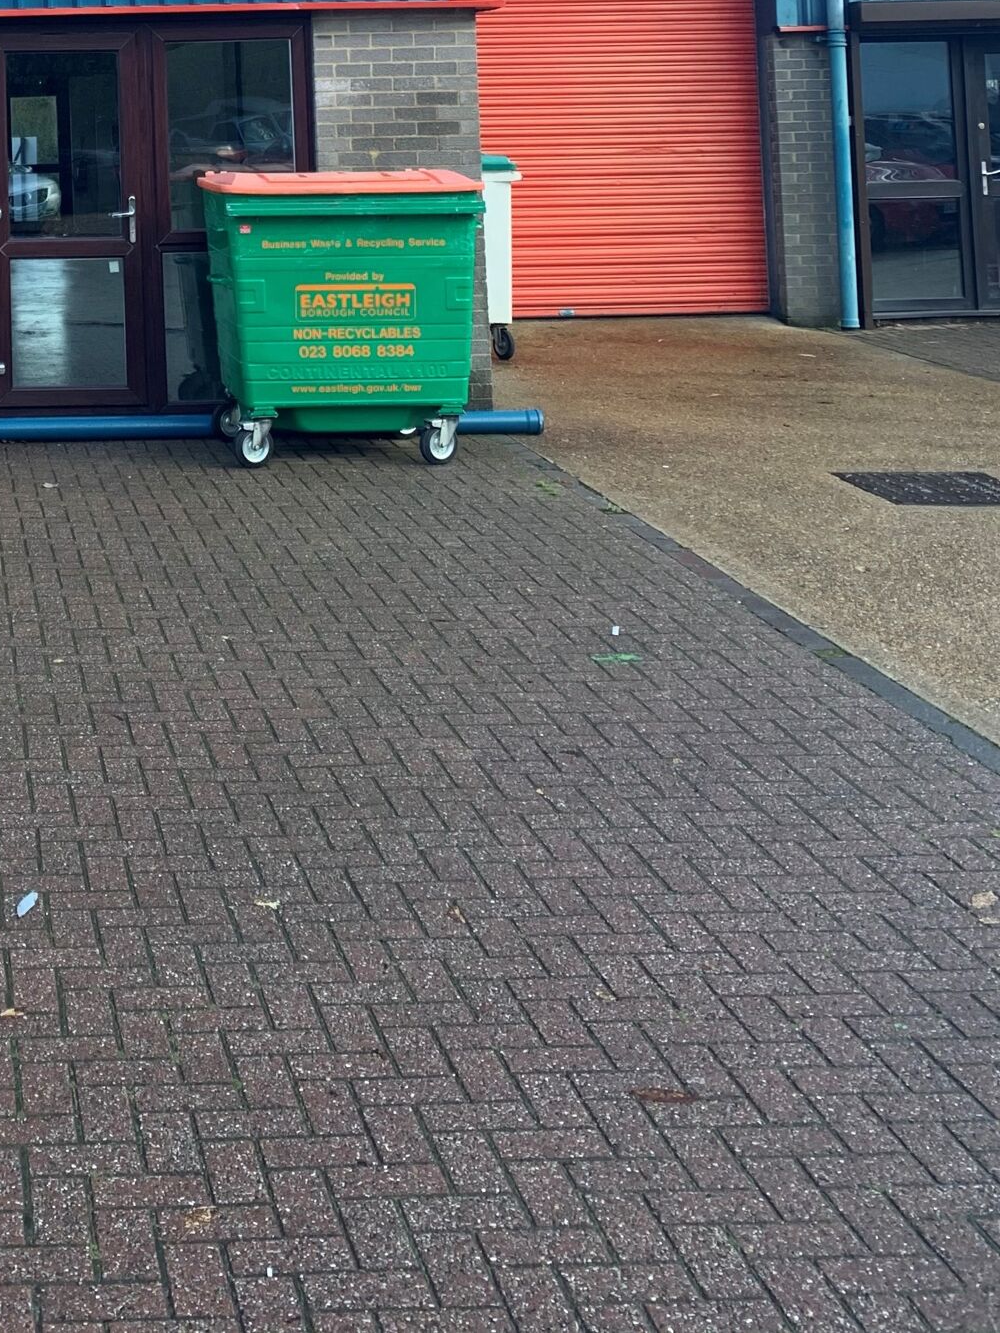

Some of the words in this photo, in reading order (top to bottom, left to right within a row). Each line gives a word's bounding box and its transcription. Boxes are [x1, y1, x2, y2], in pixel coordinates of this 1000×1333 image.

[261, 239, 307, 249] Business
[345, 238, 352, 248] &
[356, 238, 405, 249] Recycling
[408, 237, 446, 247] Service
[325, 272, 368, 281] Provided
[372, 271, 384, 282] by
[300, 293, 411, 308] EASTLEIGH
[301, 308, 356, 318] BOROUGH
[360, 307, 410, 317] COUNCIL
[292, 326, 422, 340] NON-RECYCLABLES
[298, 345, 327, 359] 023
[332, 345, 371, 358] 8068
[377, 344, 415, 358] 8384
[266, 364, 399, 380] CONTINENTAL
